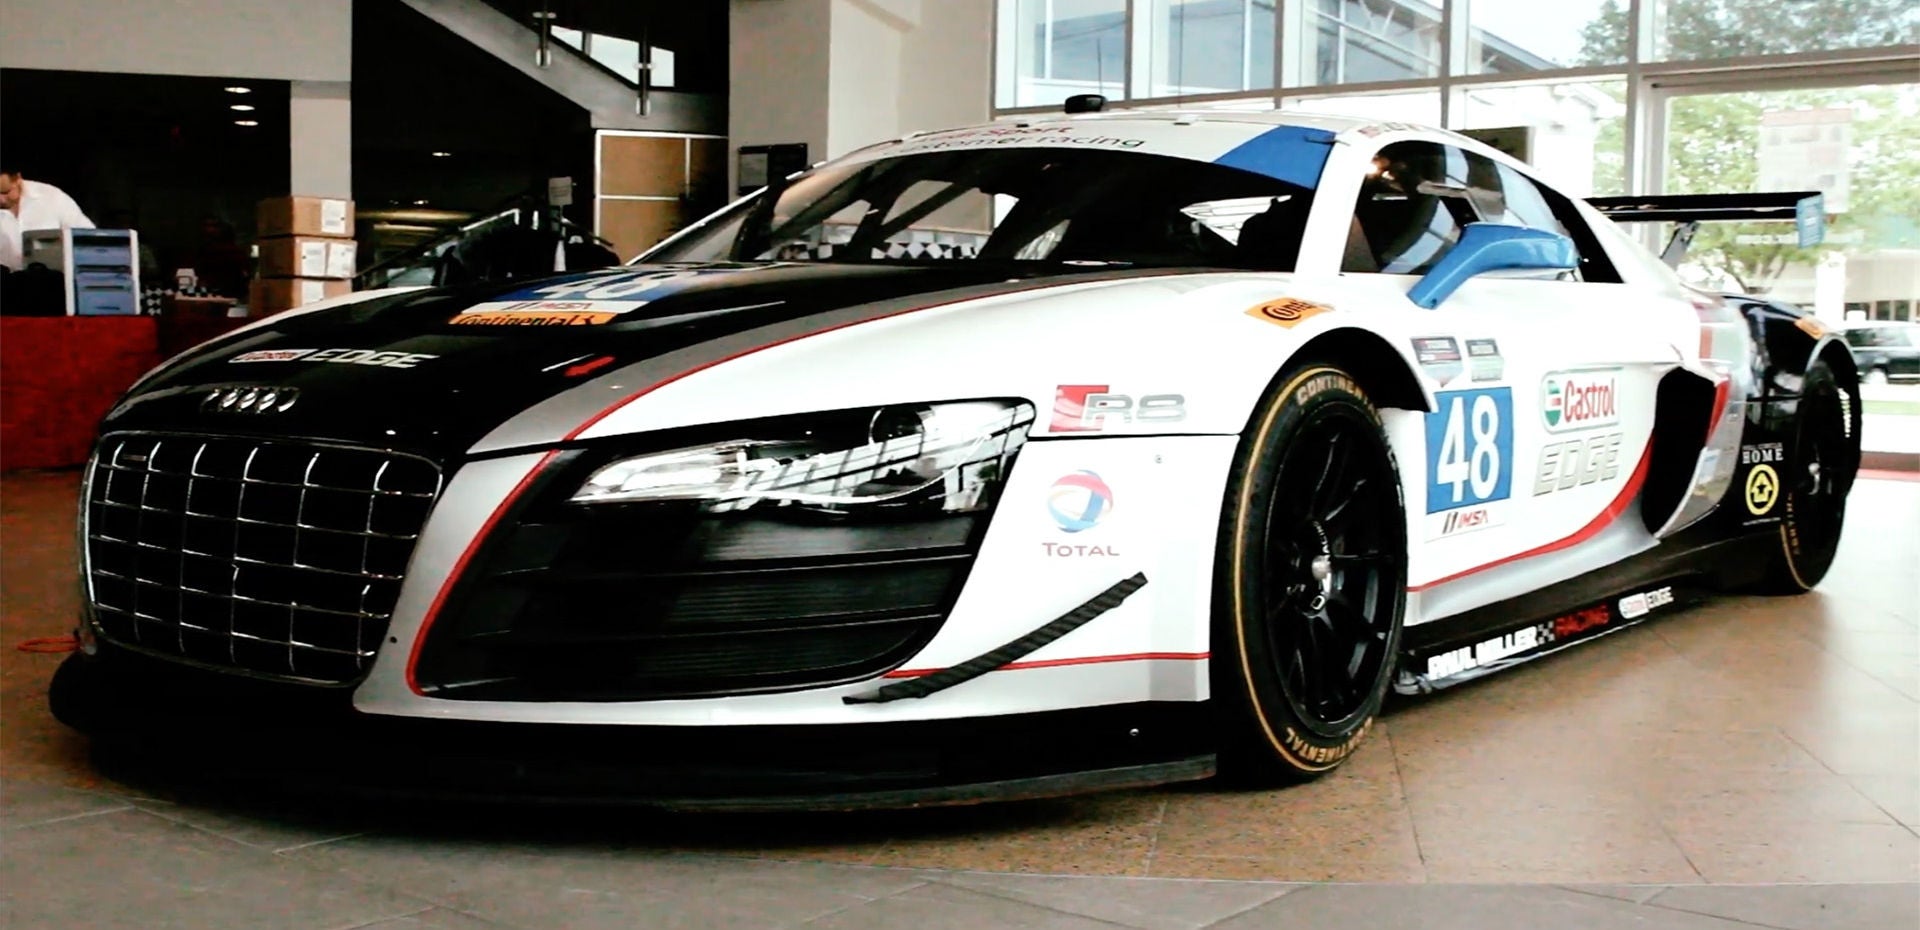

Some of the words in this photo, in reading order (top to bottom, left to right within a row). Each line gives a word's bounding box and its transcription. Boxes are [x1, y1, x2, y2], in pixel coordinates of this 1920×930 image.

[1036, 136, 1146, 149] racing
[300, 348, 440, 369] EDGE
[1083, 394, 1187, 425] R8
[1564, 378, 1615, 423] Castrol
[1436, 394, 1500, 503] 48
[1742, 448, 1784, 464] HOME
[1531, 432, 1624, 498] EDGE
[1457, 509, 1490, 529] IMSA
[1646, 586, 1674, 610] EDGE
[1428, 645, 1477, 681] PAUL
[1475, 625, 1539, 667] MILLER
